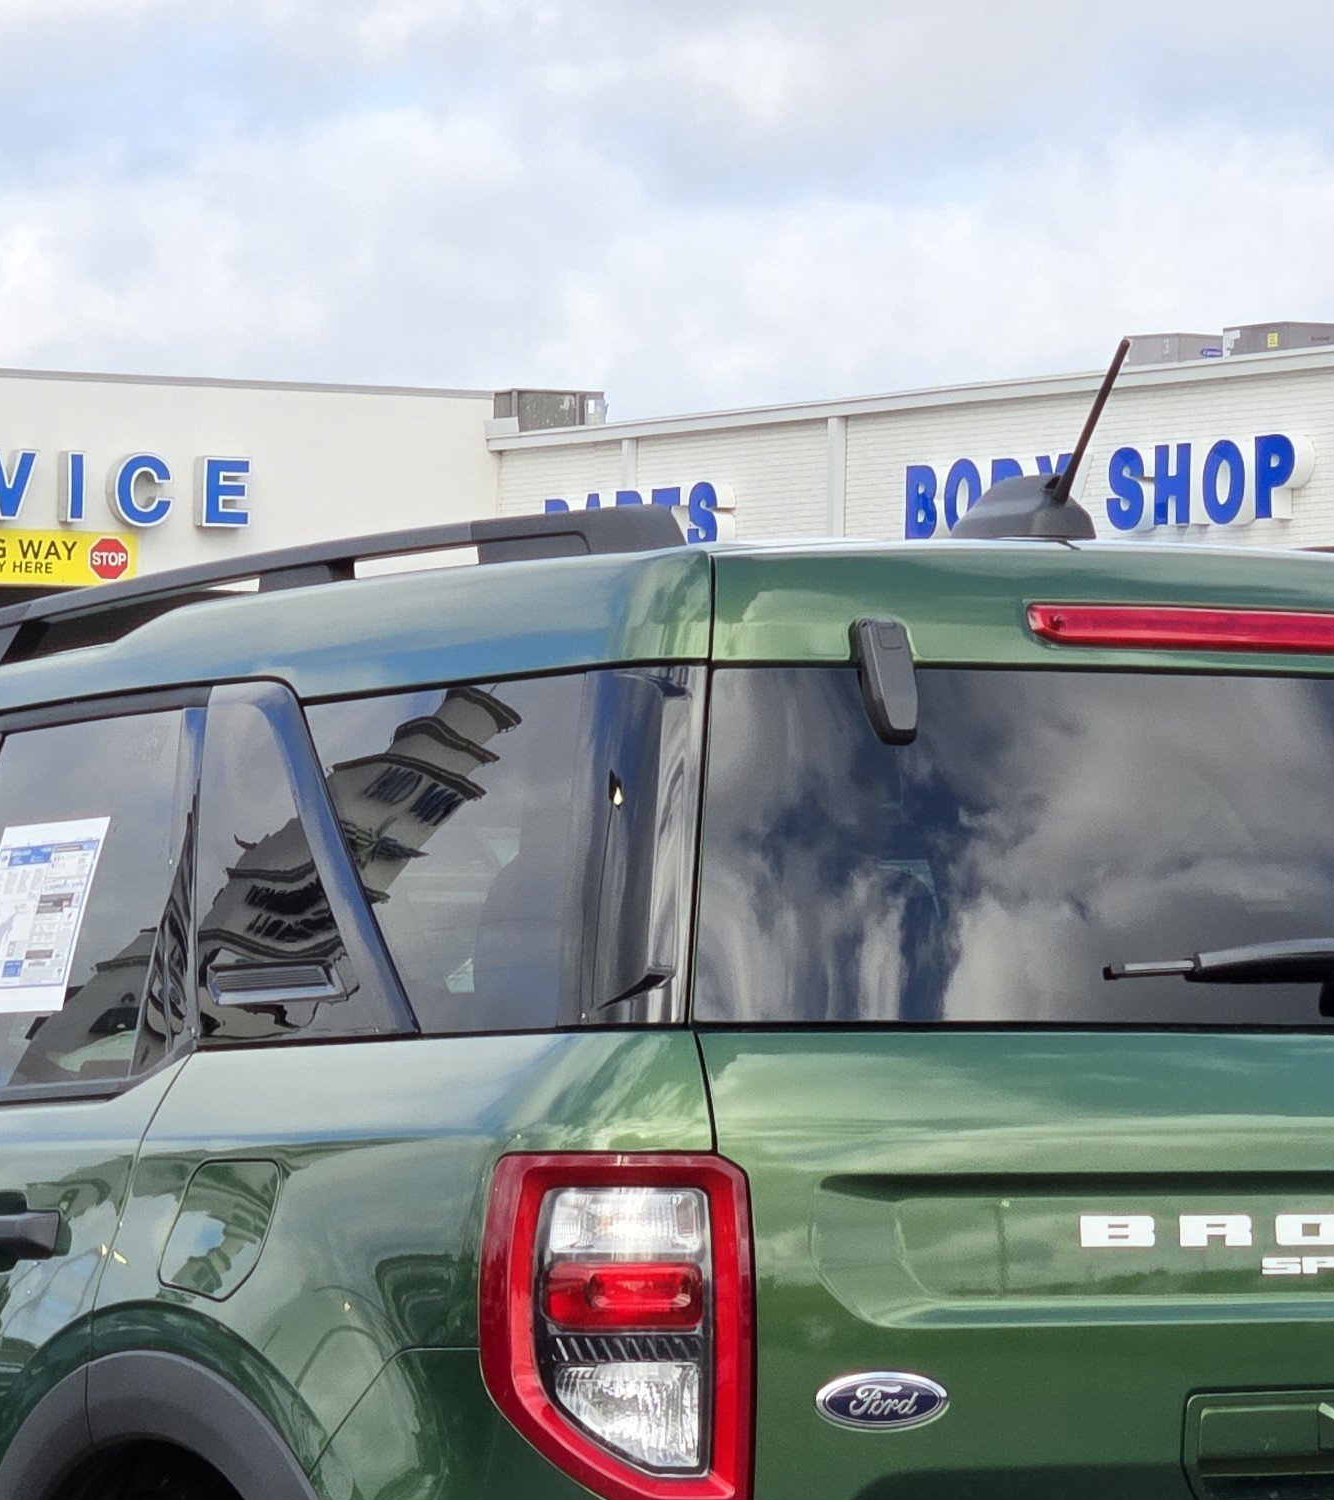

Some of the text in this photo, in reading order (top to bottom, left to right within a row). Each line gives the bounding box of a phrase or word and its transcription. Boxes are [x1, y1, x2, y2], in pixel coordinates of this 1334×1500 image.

[1105, 433, 1296, 531] SHOP
[18, 539, 78, 561] WAY
[92, 551, 127, 567] STOP
[12, 561, 54, 574] HERE
[848, 1384, 919, 1417] Ford
